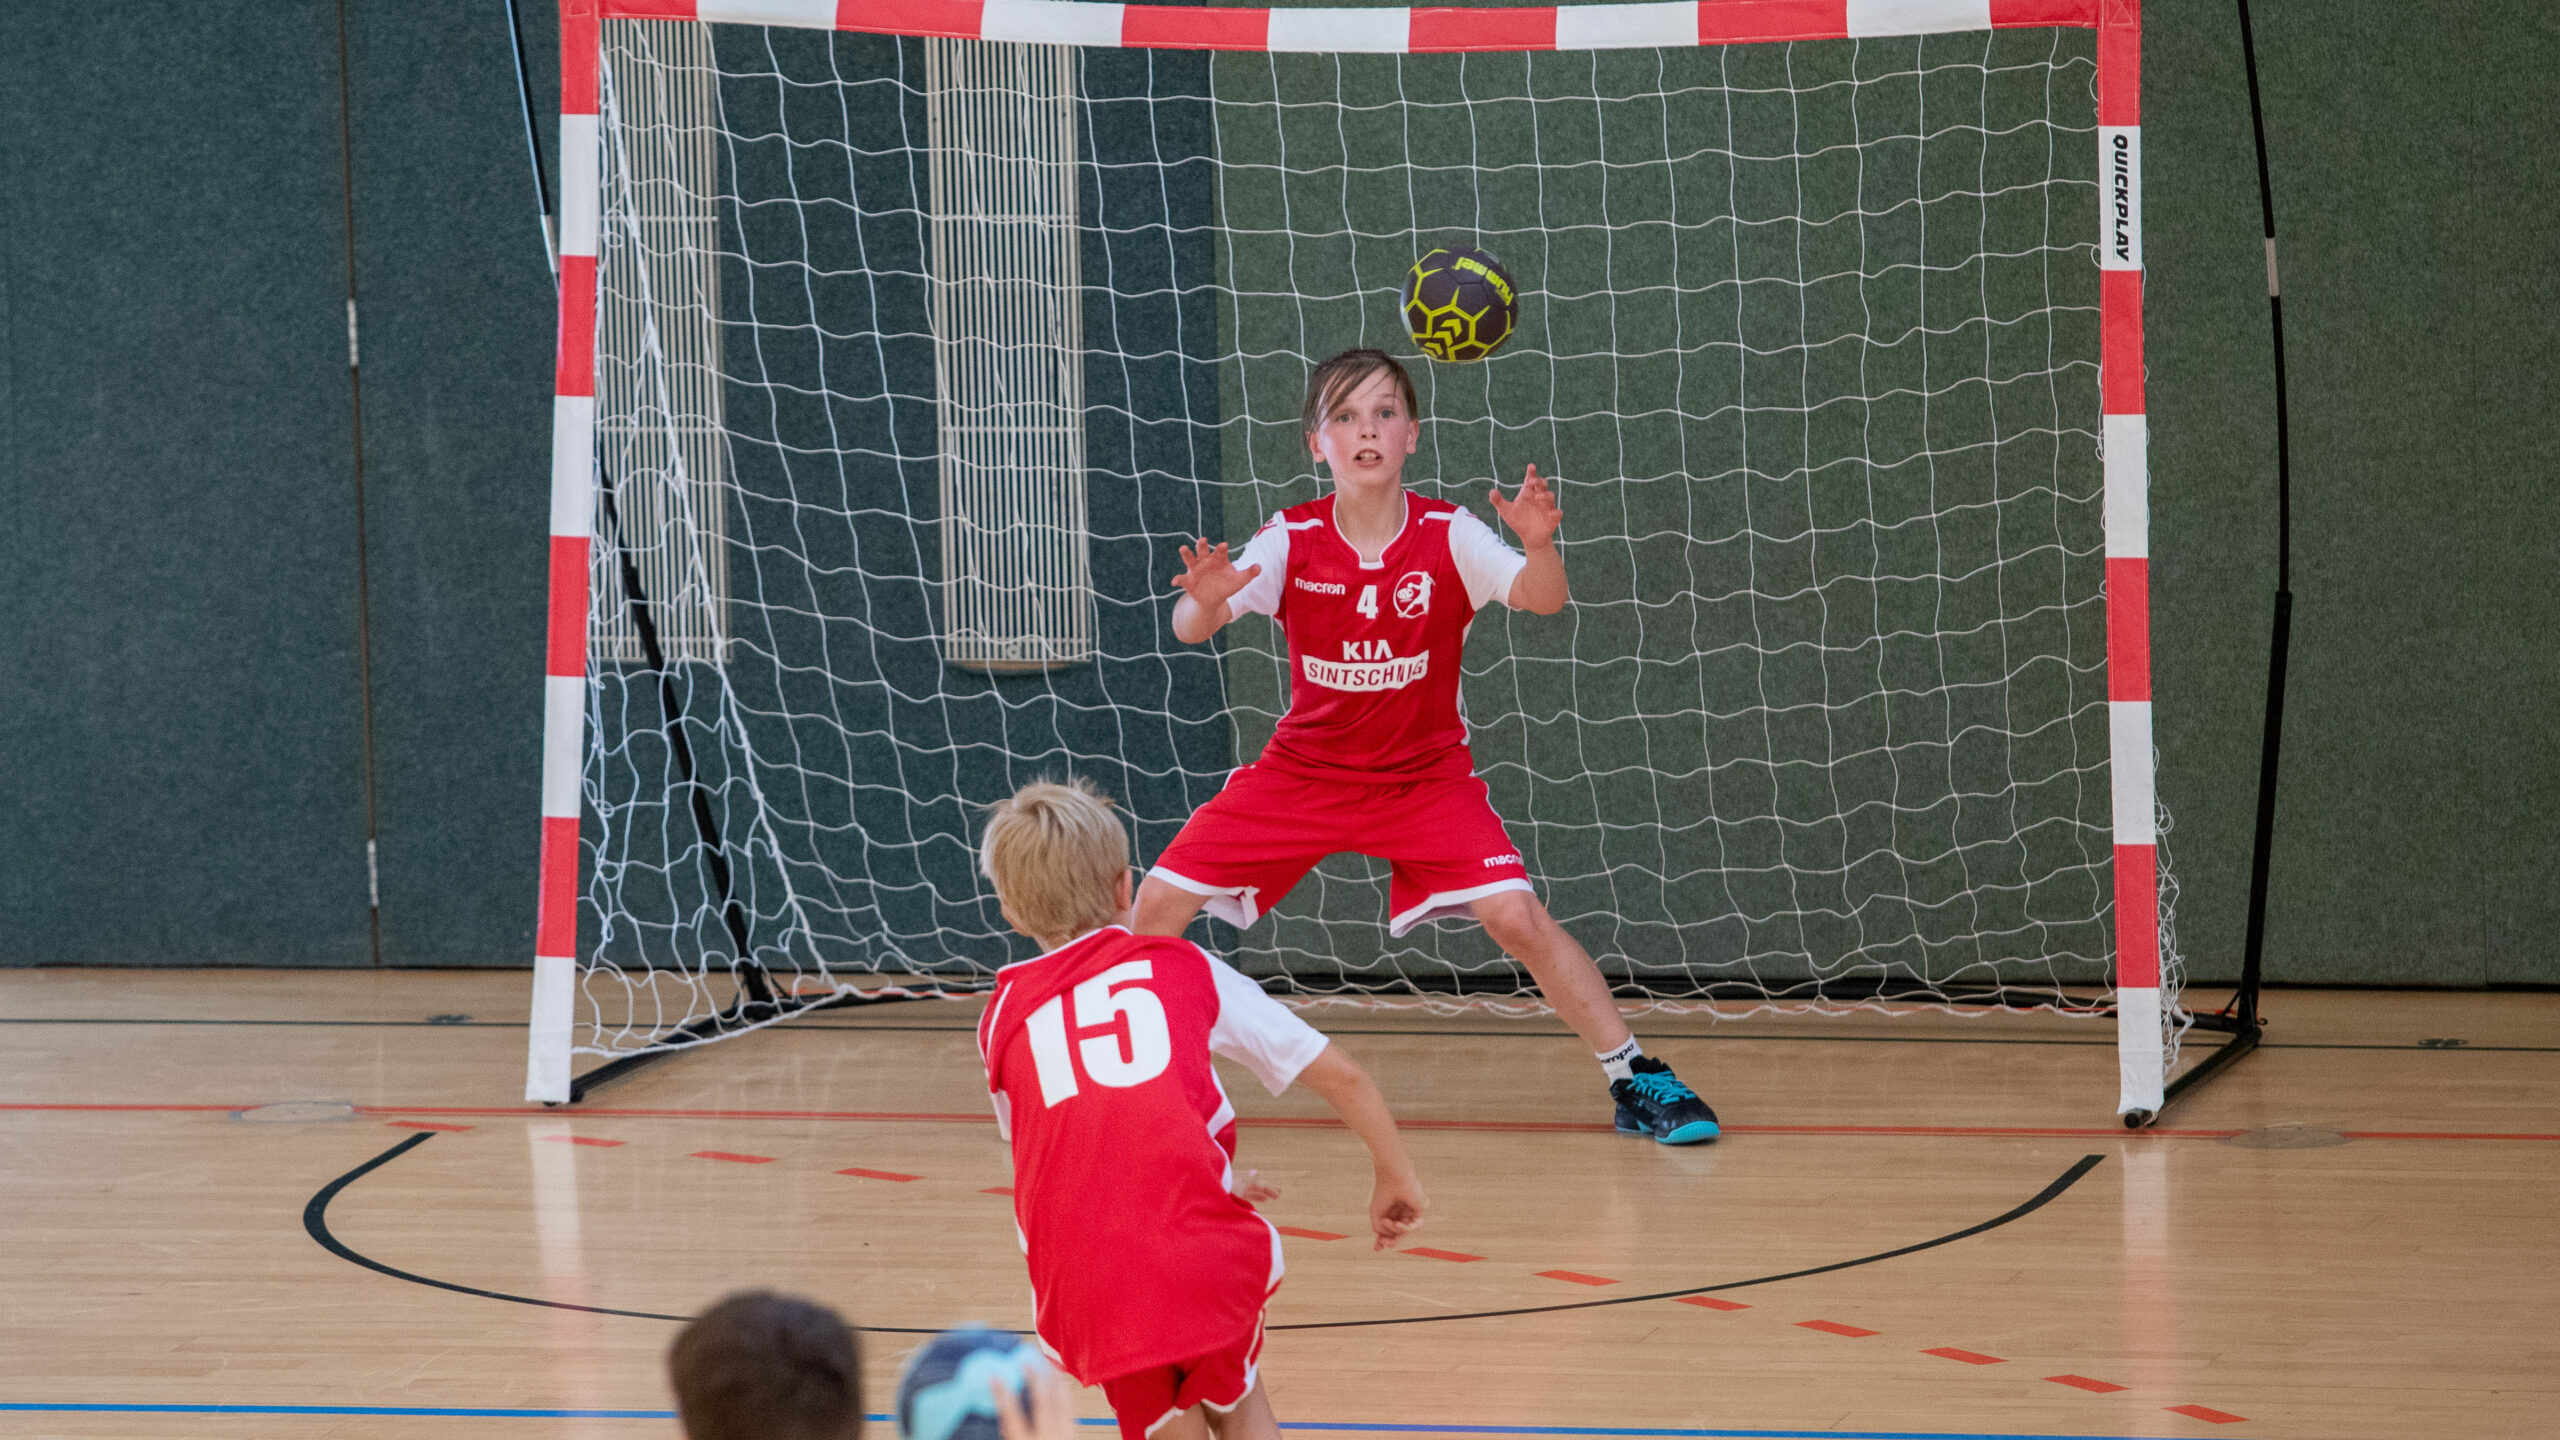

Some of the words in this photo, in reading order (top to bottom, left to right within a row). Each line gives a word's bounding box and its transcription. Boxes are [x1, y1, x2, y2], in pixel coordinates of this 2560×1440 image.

[2112, 134, 2130, 263] QUICKPLAY
[1295, 577, 1346, 596] macron
[1356, 584, 1379, 620] 4
[1342, 639, 1394, 661] KIA
[1025, 959, 1172, 1109] 15
